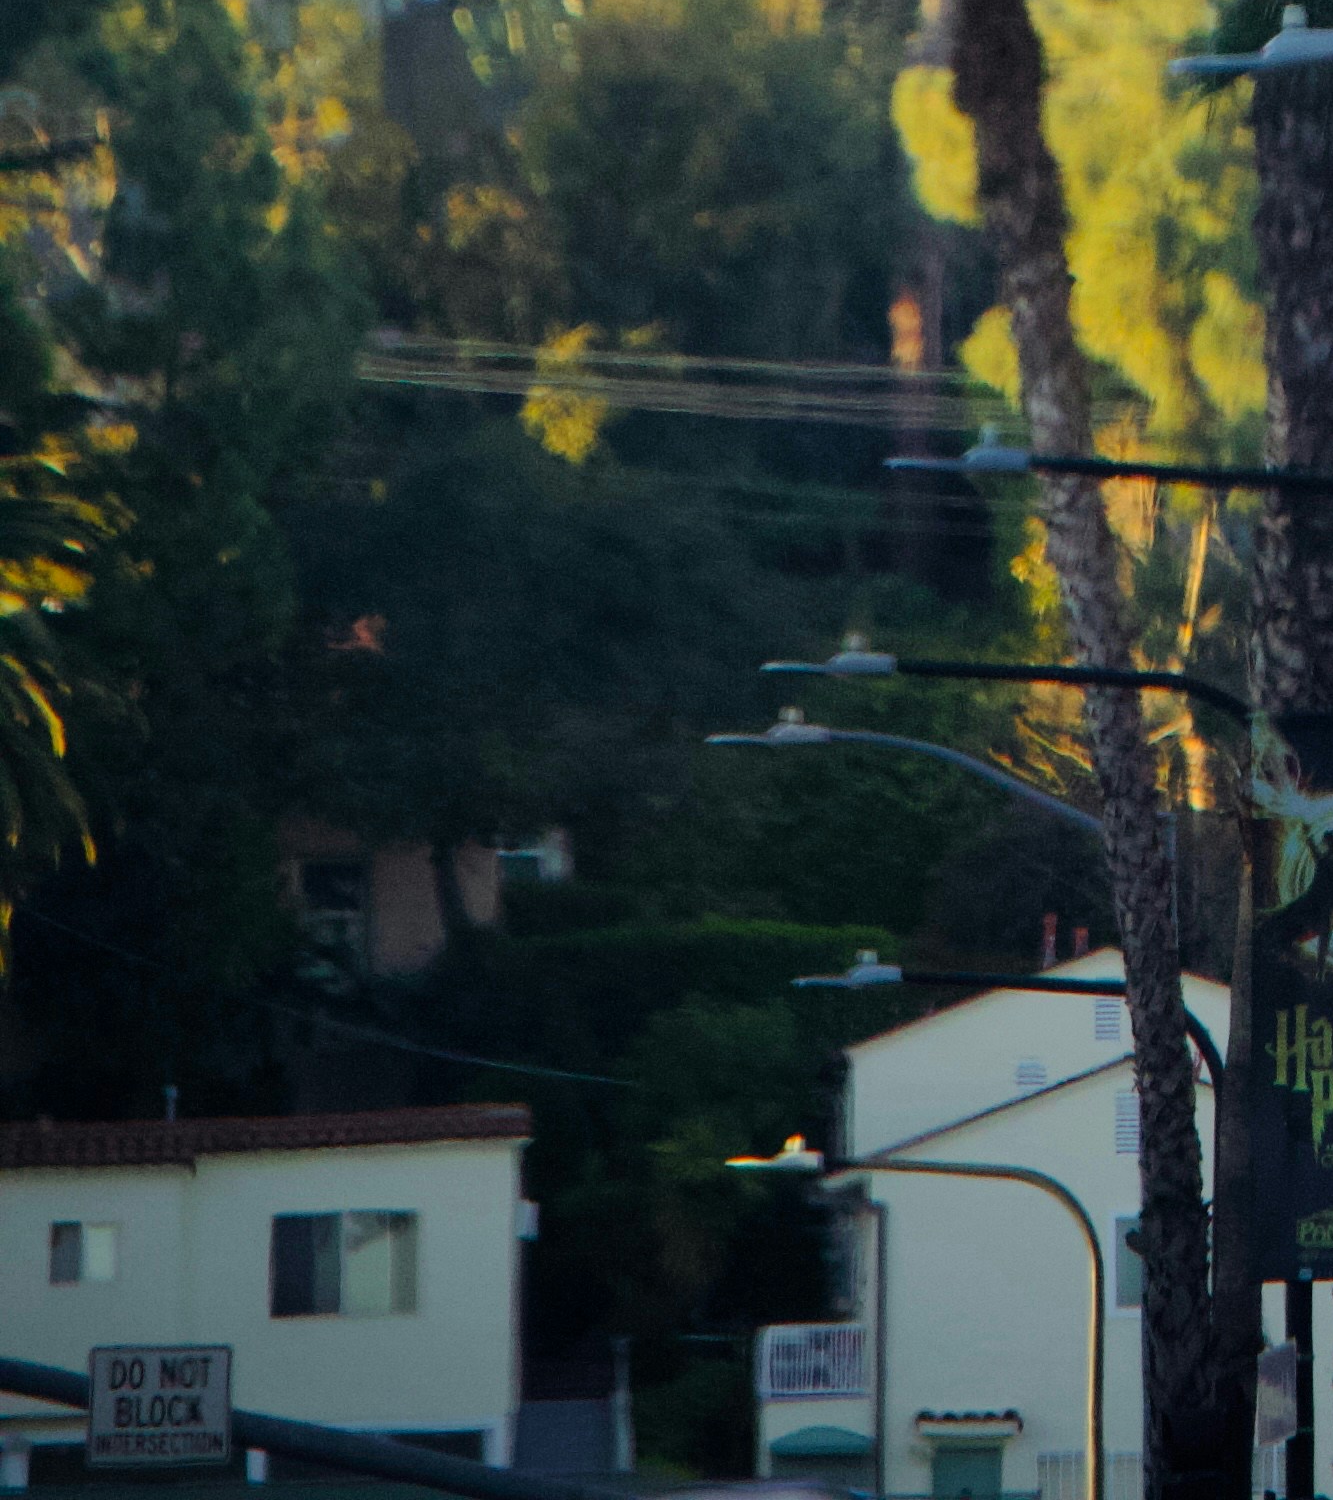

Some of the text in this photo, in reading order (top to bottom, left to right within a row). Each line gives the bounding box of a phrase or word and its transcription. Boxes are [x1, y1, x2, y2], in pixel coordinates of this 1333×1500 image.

[110, 1357, 212, 1392] DO NOT
[114, 1396, 205, 1429] BLOCK
